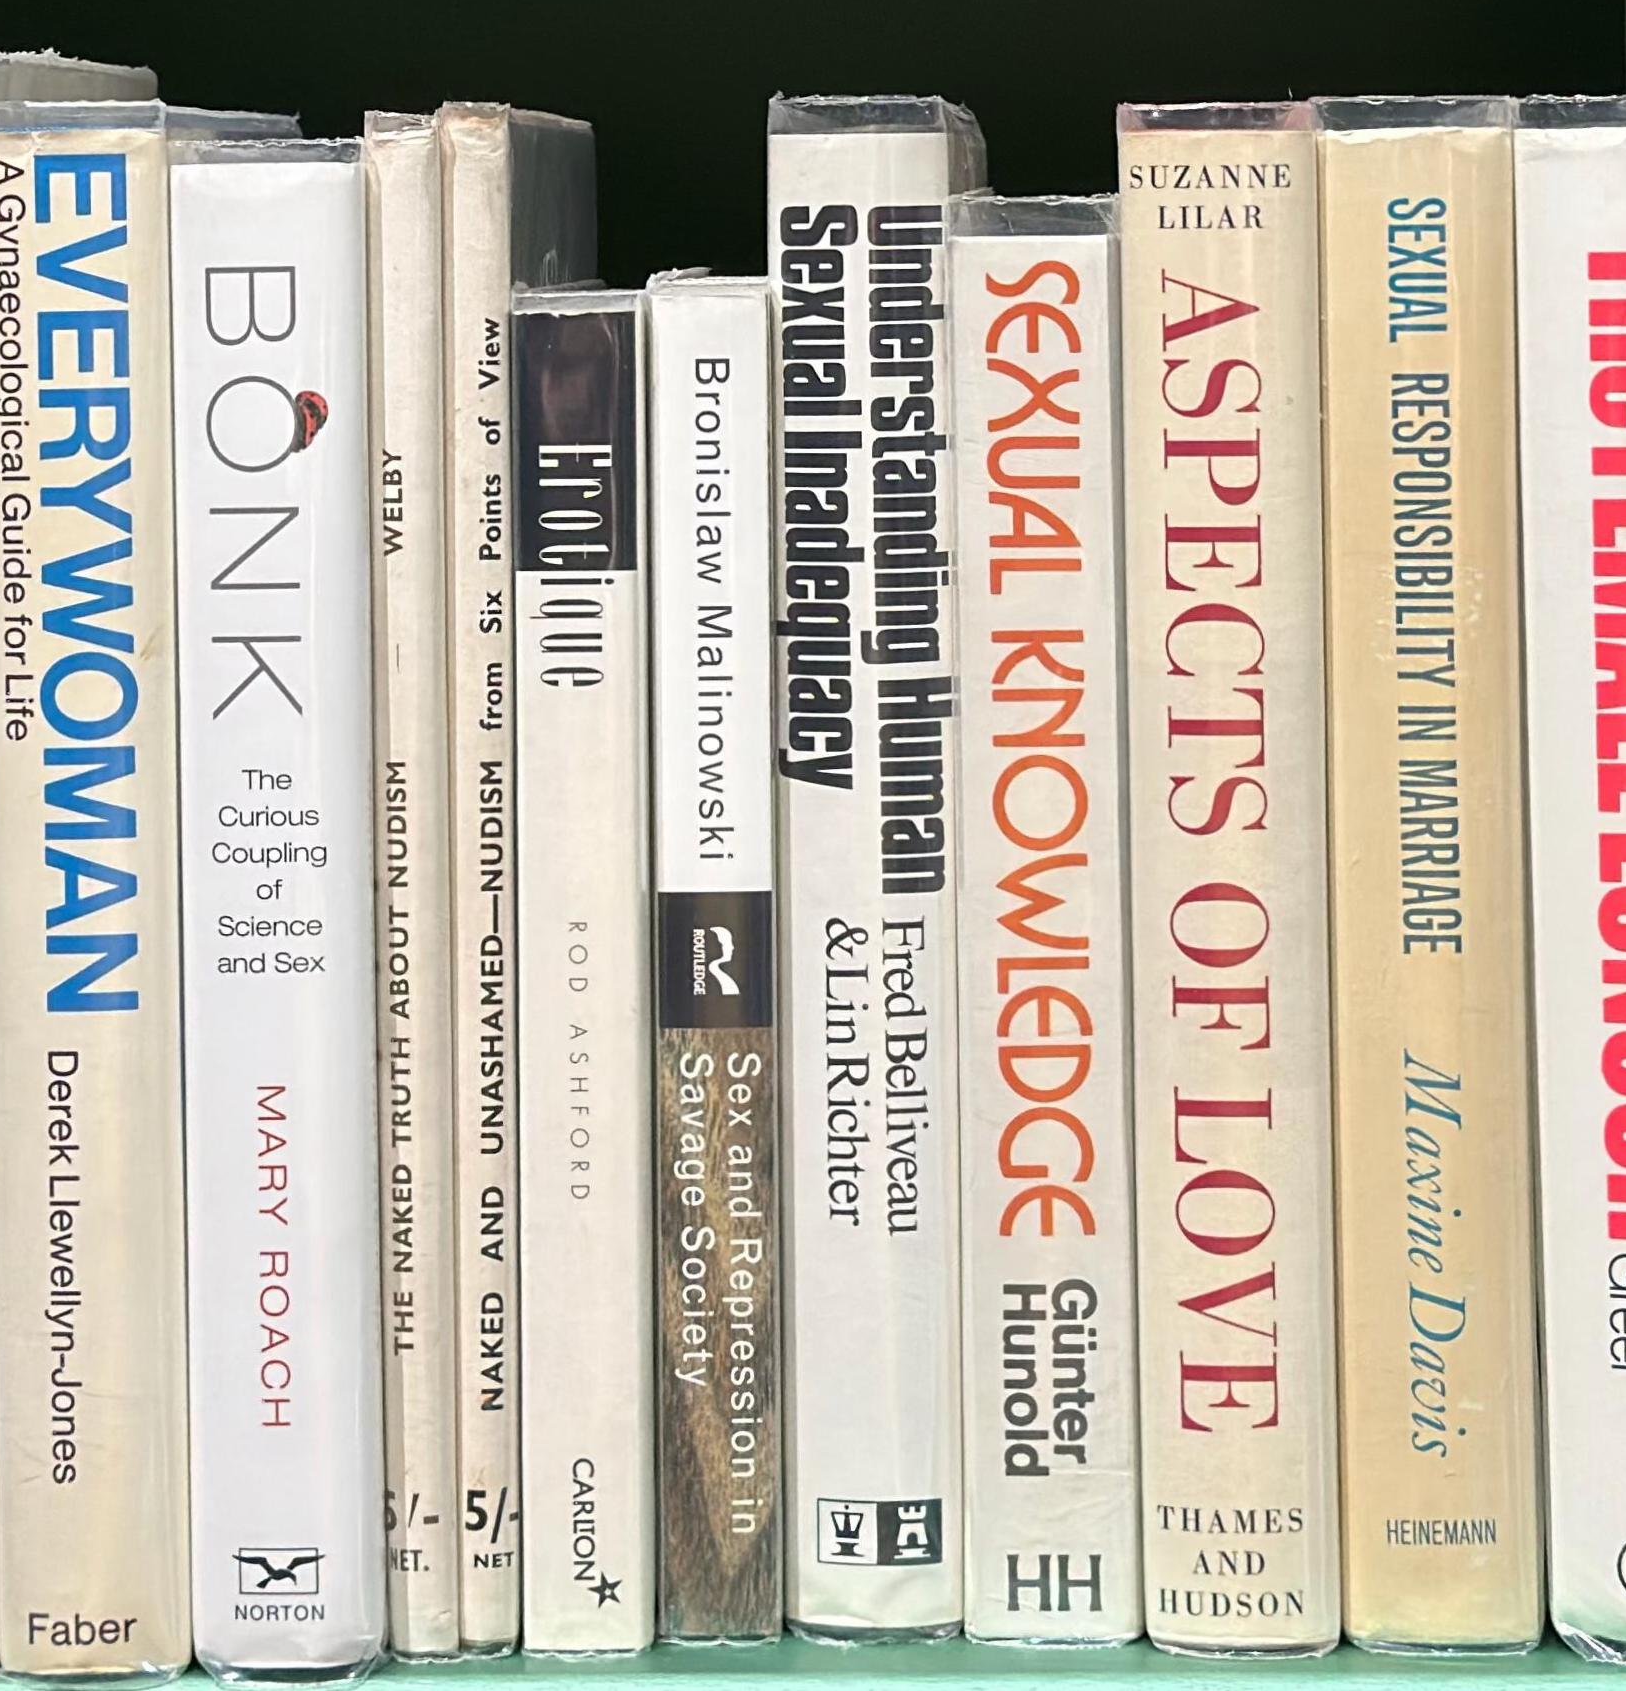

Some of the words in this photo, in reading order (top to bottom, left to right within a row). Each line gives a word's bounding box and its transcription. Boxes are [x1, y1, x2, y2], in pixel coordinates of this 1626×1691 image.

[1130, 164, 1290, 189] SUZANNE
[1159, 205, 1263, 229] LILAR
[780, 205, 862, 416] Sexual
[1388, 198, 1447, 342] SEXUAL
[206, 266, 303, 719] BONK
[695, 358, 731, 583] Bronislaw
[861, 206, 948, 664] Understanding
[986, 261, 1081, 595] SEXUAL
[34, 154, 138, 1012] EVERYWOMAN
[530, 444, 615, 687] Erotique
[1162, 269, 1267, 835] ASPECTS
[1392, 374, 1455, 687] RESPONSIBILITY
[777, 430, 865, 790] Inadequacy
[242, 770, 292, 790] The
[697, 606, 734, 858] Malinowski
[875, 676, 953, 894] Human
[1398, 706, 1456, 740] IN
[212, 842, 327, 868] Coupling
[219, 806, 319, 827] Curious
[257, 879, 283, 900] of
[1399, 760, 1462, 954] MARRIAGE
[218, 916, 322, 937] Science
[218, 953, 265, 973] and
[275, 952, 325, 973] Sex
[569, 922, 588, 992] ROD
[693, 929, 706, 995] ROUTLEDGE
[826, 918, 868, 960] &
[883, 916, 927, 1020] Fred
[992, 630, 1096, 1236] KNOWLEDGE
[1170, 883, 1270, 1050] OF
[826, 965, 868, 1044] Lin
[48, 1051, 79, 1165] Derek
[257, 1086, 288, 1225] MARY
[570, 1025, 590, 1199] ASHFORD
[674, 1053, 714, 1206] Savage
[728, 1053, 761, 1126] Sex
[827, 1053, 870, 1226] Richter
[885, 1028, 929, 1236] Belliveau
[1404, 1049, 1461, 1273] Maxine
[728, 1146, 762, 1217] and
[45, 1176, 82, 1484] Llewellyn-Jones
[675, 1227, 715, 1386] Society
[1174, 1086, 1278, 1432] LOVE
[260, 1252, 291, 1426] ROACH
[727, 1239, 762, 1477] Repression
[1003, 1284, 1049, 1476] Hunold
[1052, 1279, 1097, 1464] Günter
[1409, 1282, 1466, 1457] Davis
[474, 1552, 514, 1568] NET
[573, 1458, 595, 1580] CARLTON
[732, 1499, 763, 1533] in
[1157, 1505, 1302, 1533] THAMES
[1192, 1550, 1265, 1576] AND
[1387, 1519, 1496, 1545] HEINEMANN
[29, 1613, 137, 1645] Faber
[235, 1605, 324, 1621] NORTON
[1161, 1589, 1303, 1616] HUDSON
